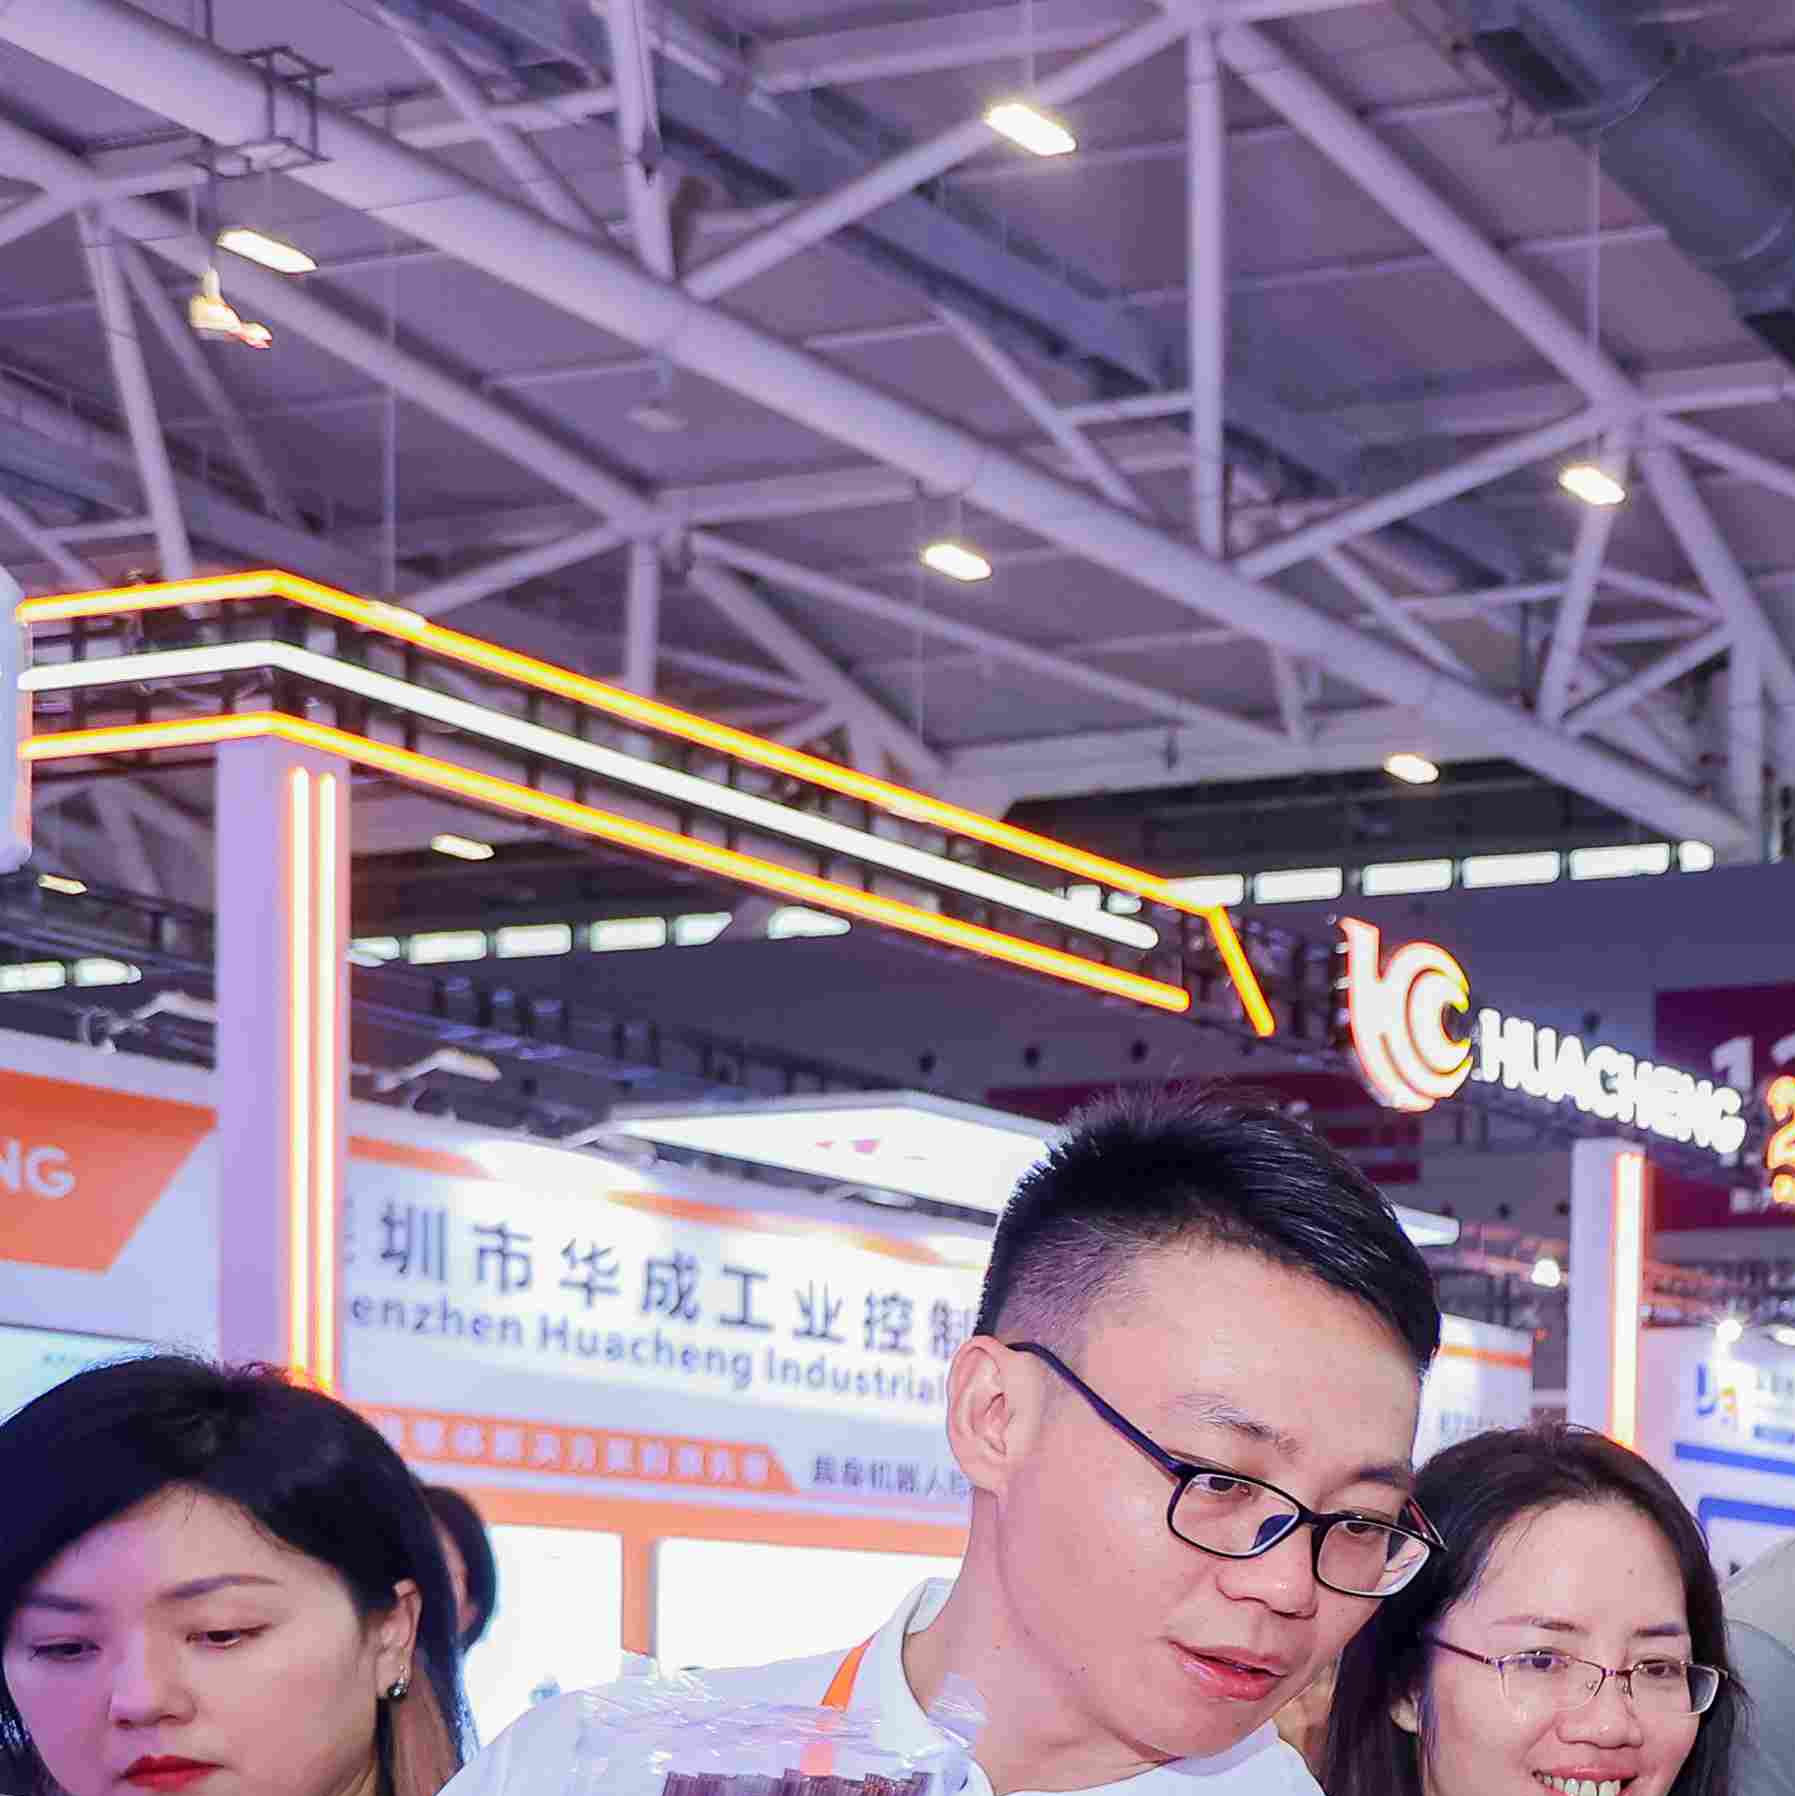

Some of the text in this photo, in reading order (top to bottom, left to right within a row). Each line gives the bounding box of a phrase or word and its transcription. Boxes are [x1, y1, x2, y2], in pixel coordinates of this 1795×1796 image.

[343, 1197, 978, 1363] 圳市华成工业控制
[343, 1295, 524, 1347] enzhen
[539, 1314, 754, 1391] Huacheng
